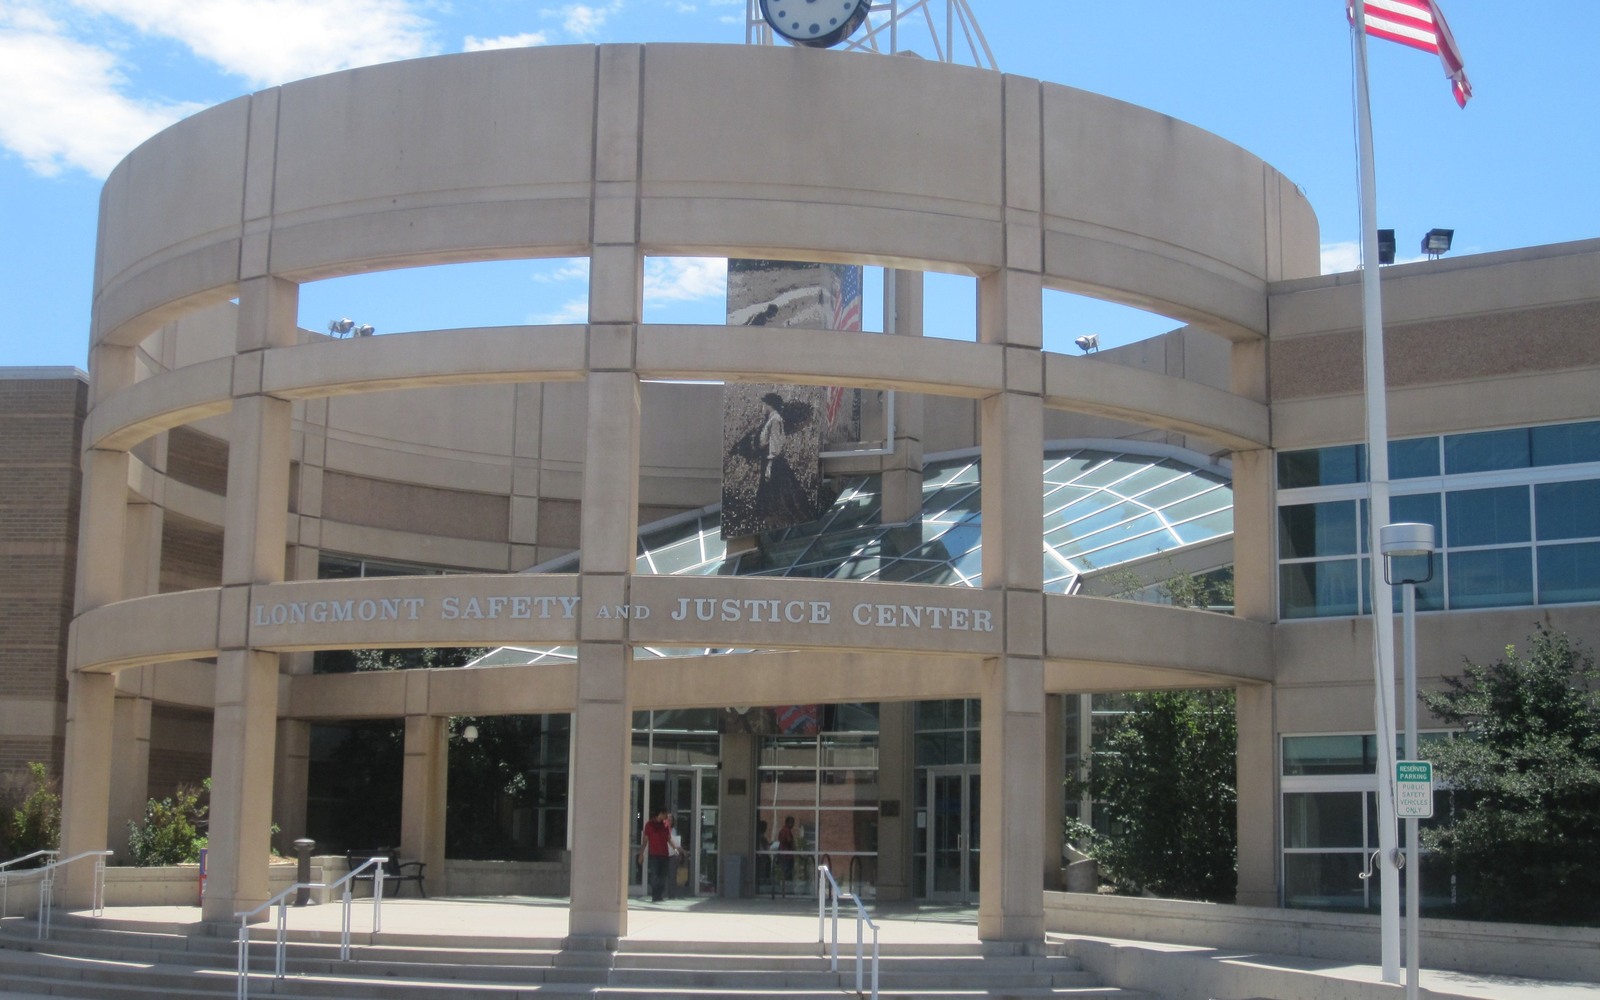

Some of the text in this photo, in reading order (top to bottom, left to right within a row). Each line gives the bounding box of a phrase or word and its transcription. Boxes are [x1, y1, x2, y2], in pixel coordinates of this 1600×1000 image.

[255, 596, 995, 633] LONGMONT SAFETY AND JUSTICE CENTER
